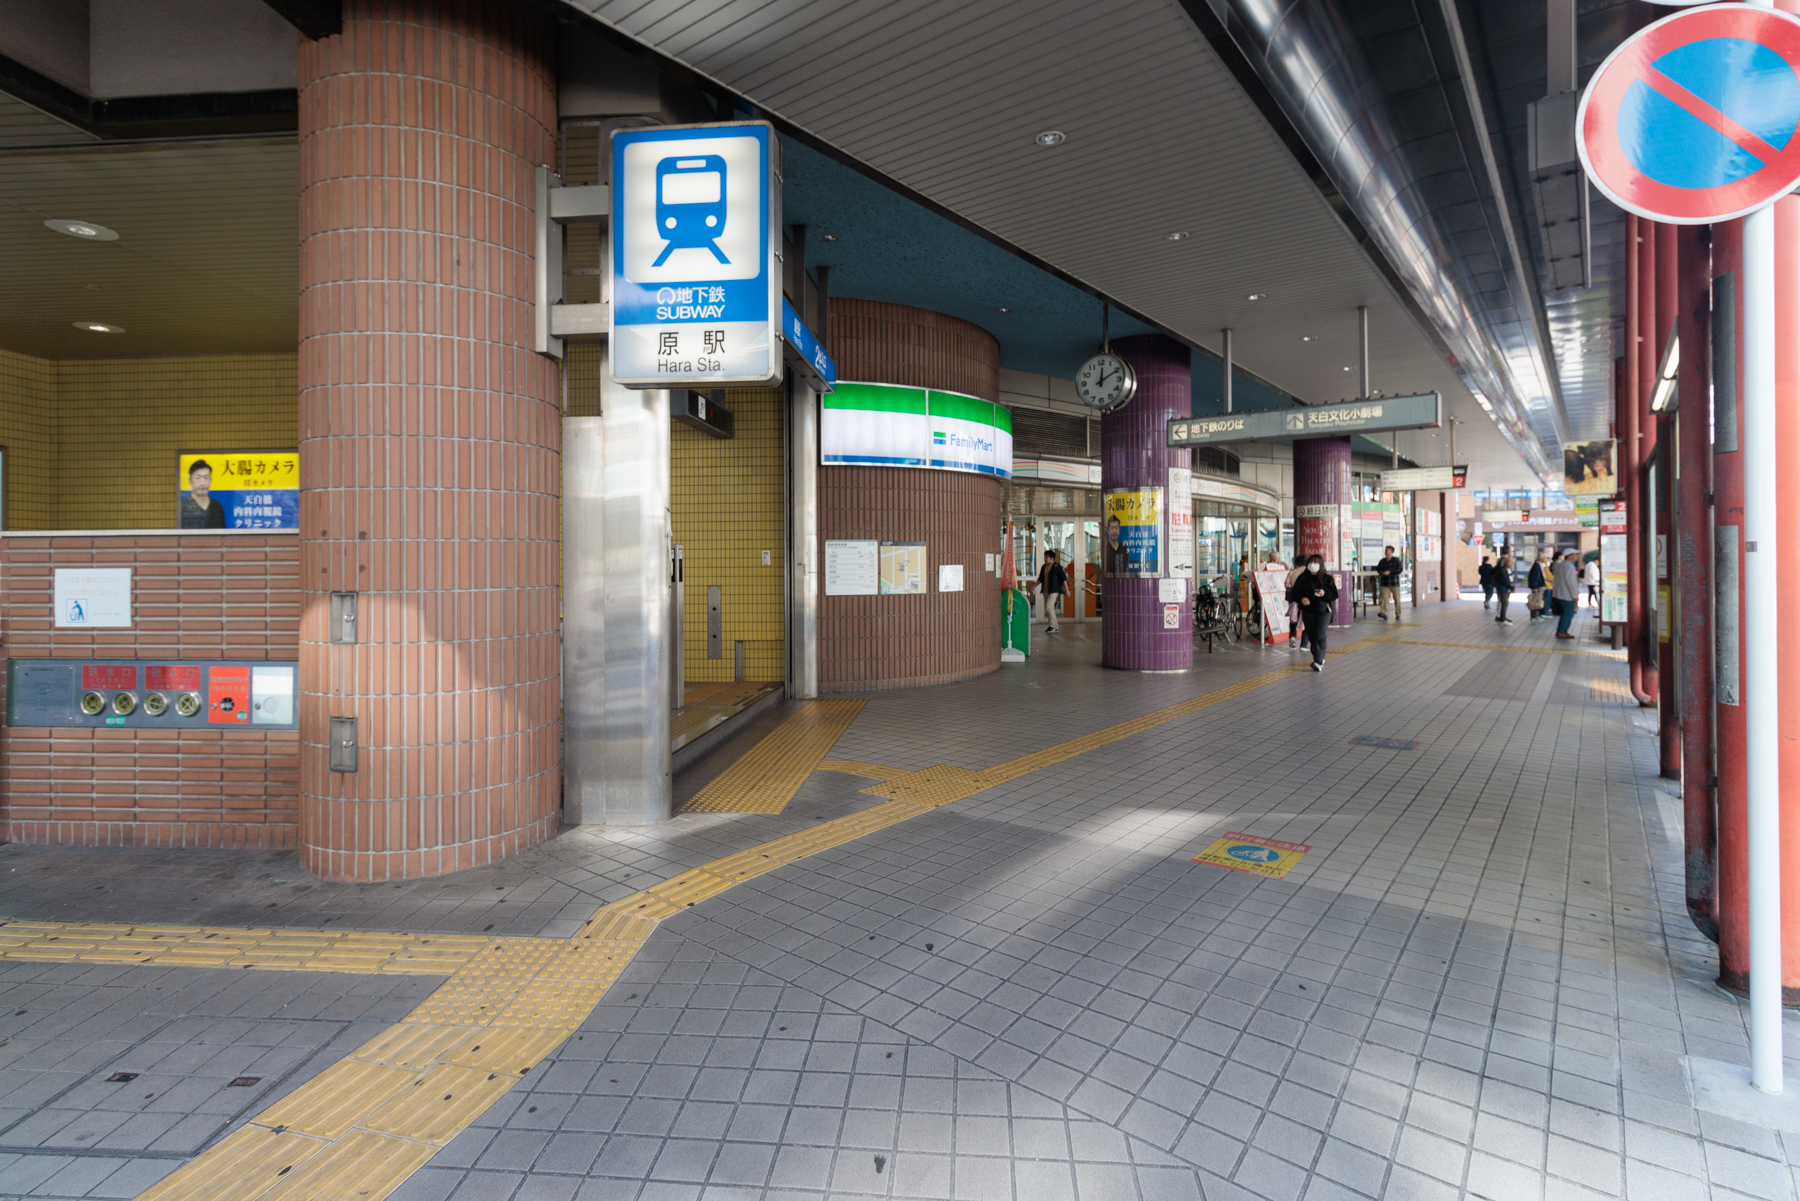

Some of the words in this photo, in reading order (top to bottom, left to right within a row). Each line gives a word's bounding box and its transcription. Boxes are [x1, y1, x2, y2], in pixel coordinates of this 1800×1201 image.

[676, 286, 726, 304] 地下鉄
[656, 304, 726, 320] SUBWAY
[658, 358, 692, 373] Hara
[697, 357, 725, 372] Sta.
[1308, 405, 1383, 424] 天白文化小劇場
[1190, 419, 1244, 434] 地下鉄のりば
[950, 433, 993, 452] FamilyMart
[221, 459, 295, 477] 大腸カメラ
[1455, 477, 1463, 486] 2
[1108, 497, 1155, 512] 大腸カメラ
[1618, 502, 1626, 511] 2
[234, 518, 282, 528] クリニック
[88, 667, 131, 677] 送水口
